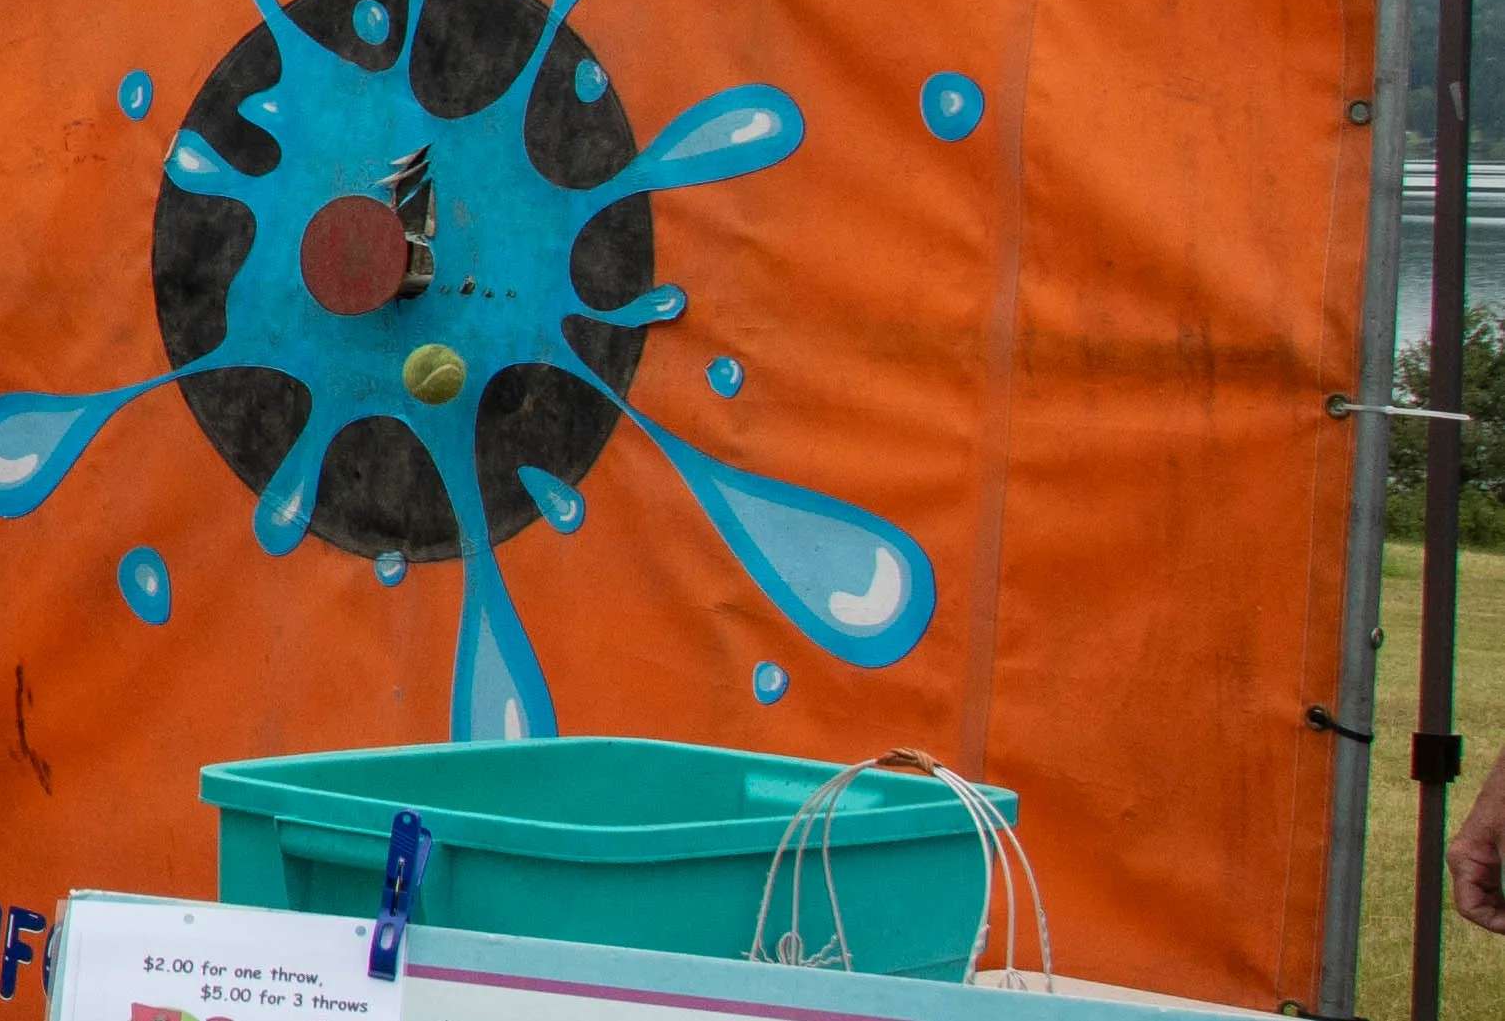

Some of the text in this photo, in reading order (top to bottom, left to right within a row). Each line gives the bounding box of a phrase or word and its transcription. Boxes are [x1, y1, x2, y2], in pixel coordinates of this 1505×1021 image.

[143, 955, 323, 988] $2.00 for one throw,
[200, 983, 369, 1014] $5.00 for 3 throws
